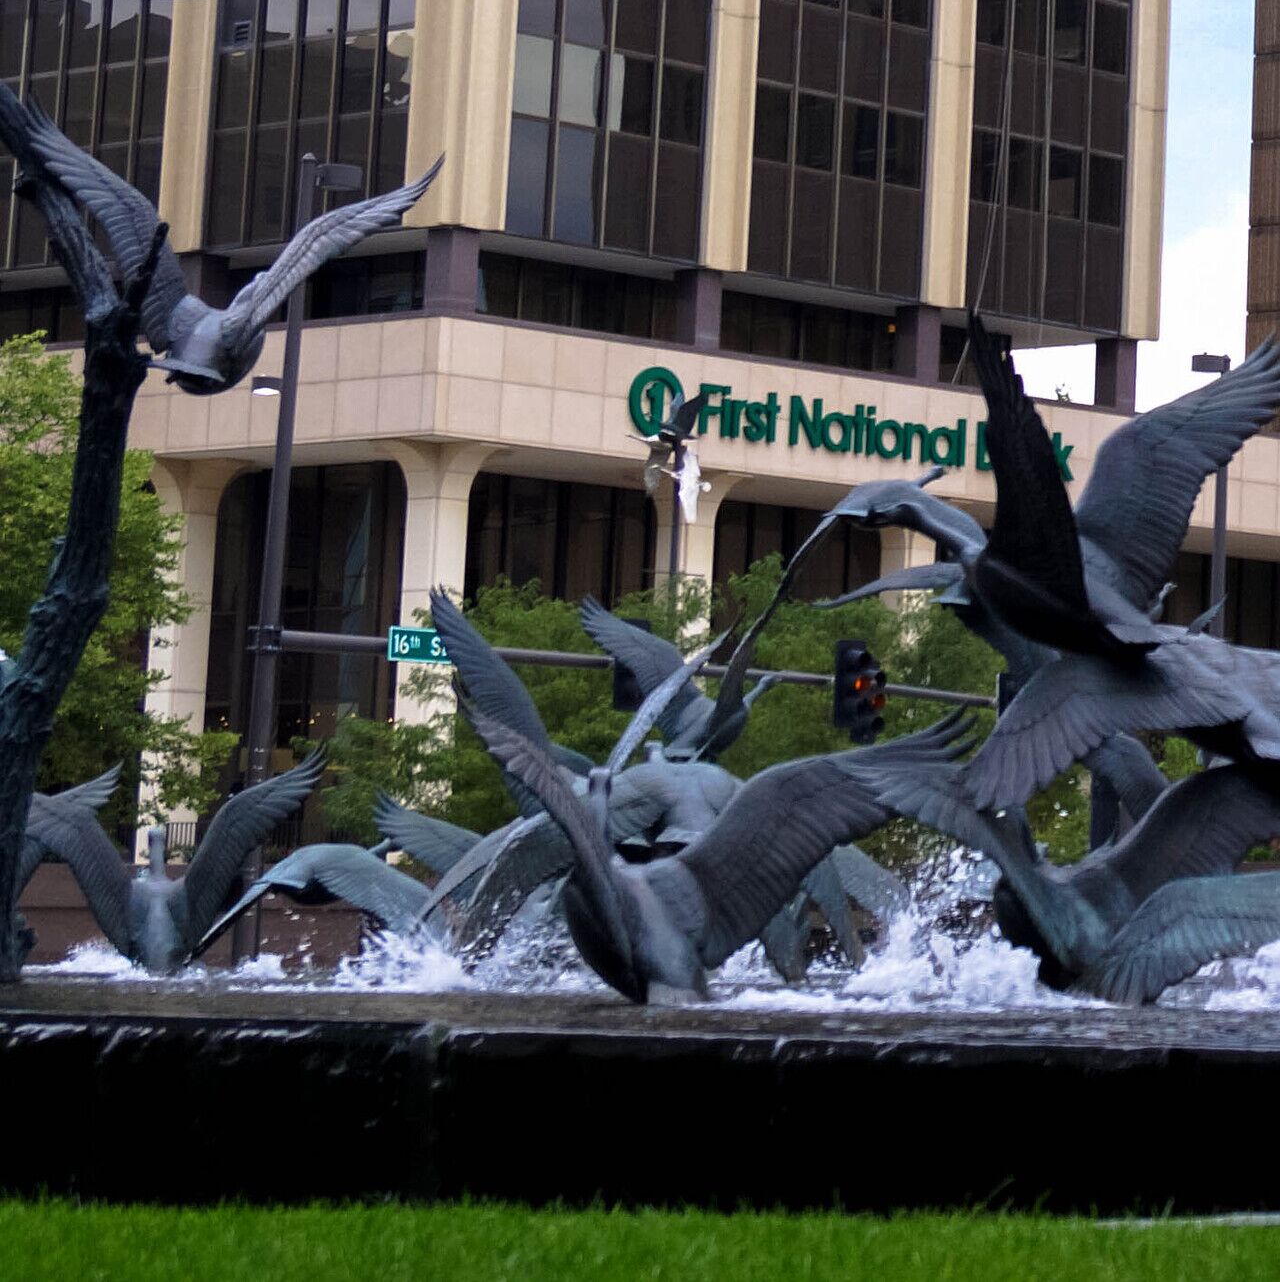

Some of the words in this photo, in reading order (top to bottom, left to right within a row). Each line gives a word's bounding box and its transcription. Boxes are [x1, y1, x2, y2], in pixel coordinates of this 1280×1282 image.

[698, 382, 780, 443] First
[788, 395, 967, 467] National
[393, 633, 421, 655] 16th
